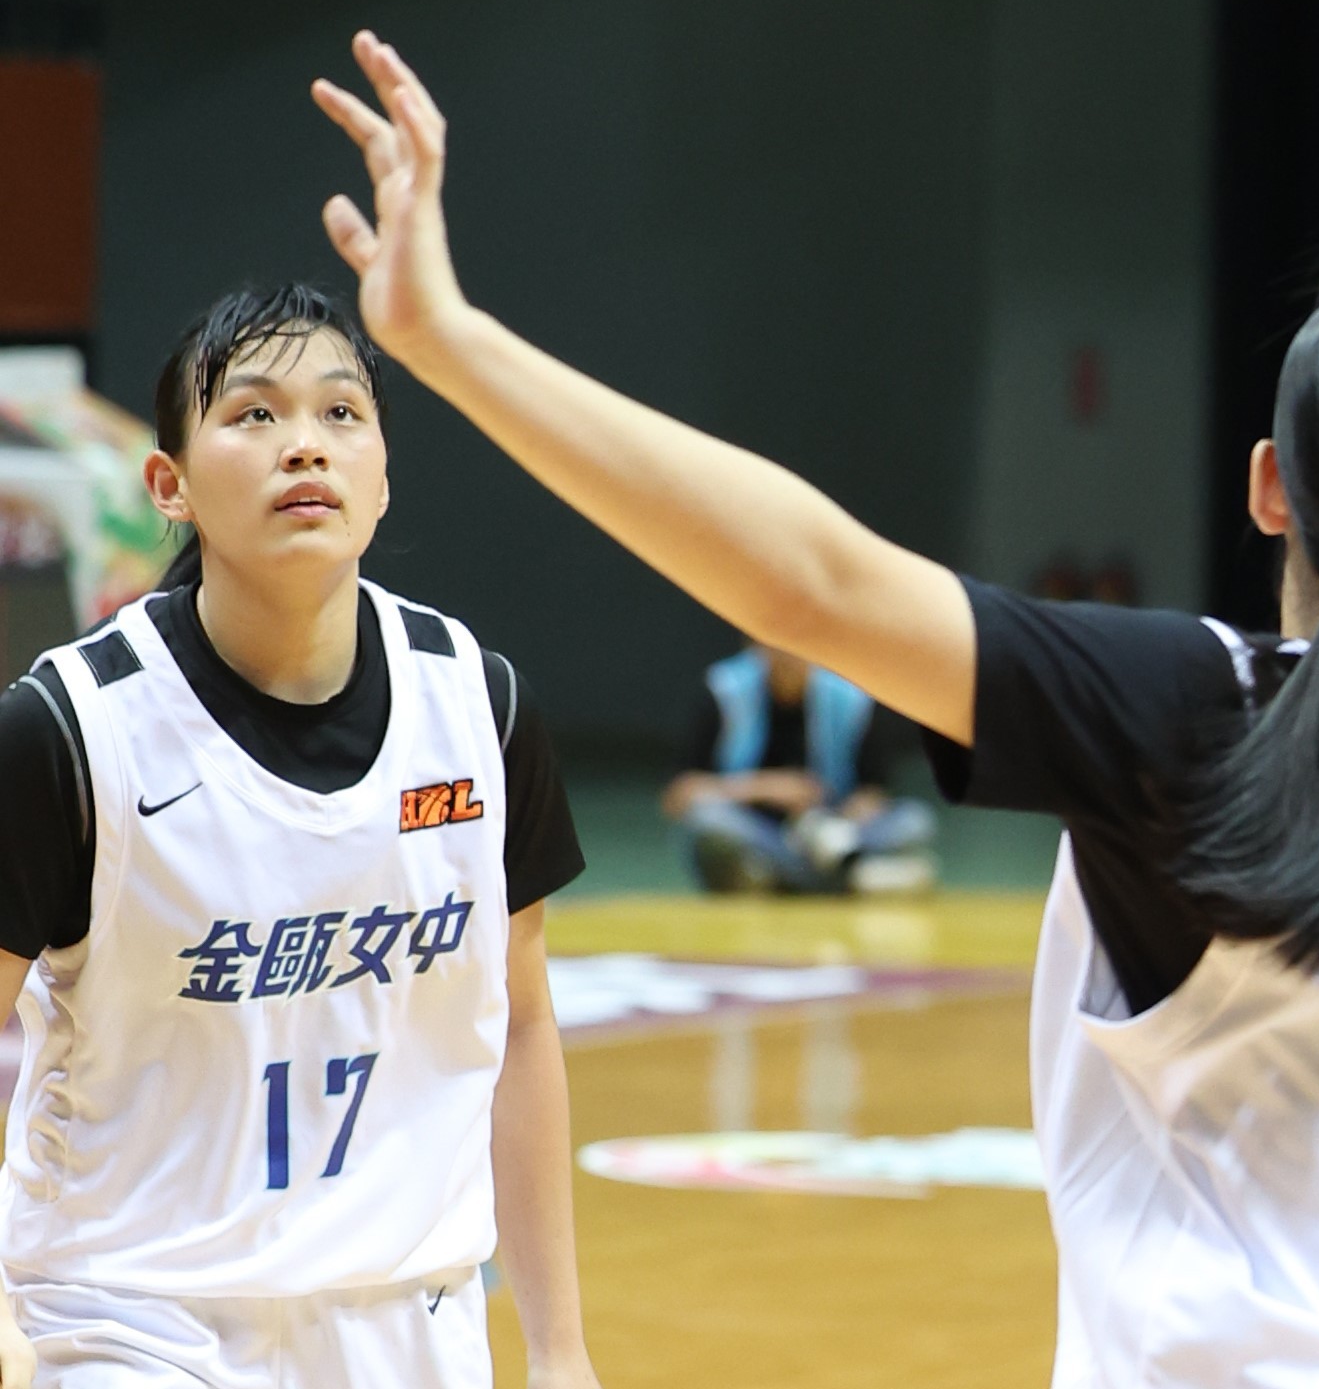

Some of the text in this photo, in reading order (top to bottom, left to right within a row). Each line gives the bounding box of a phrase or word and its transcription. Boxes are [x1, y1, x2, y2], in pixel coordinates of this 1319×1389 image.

[178, 890, 475, 1004] 金甌女中
[262, 1051, 380, 1190] 17
